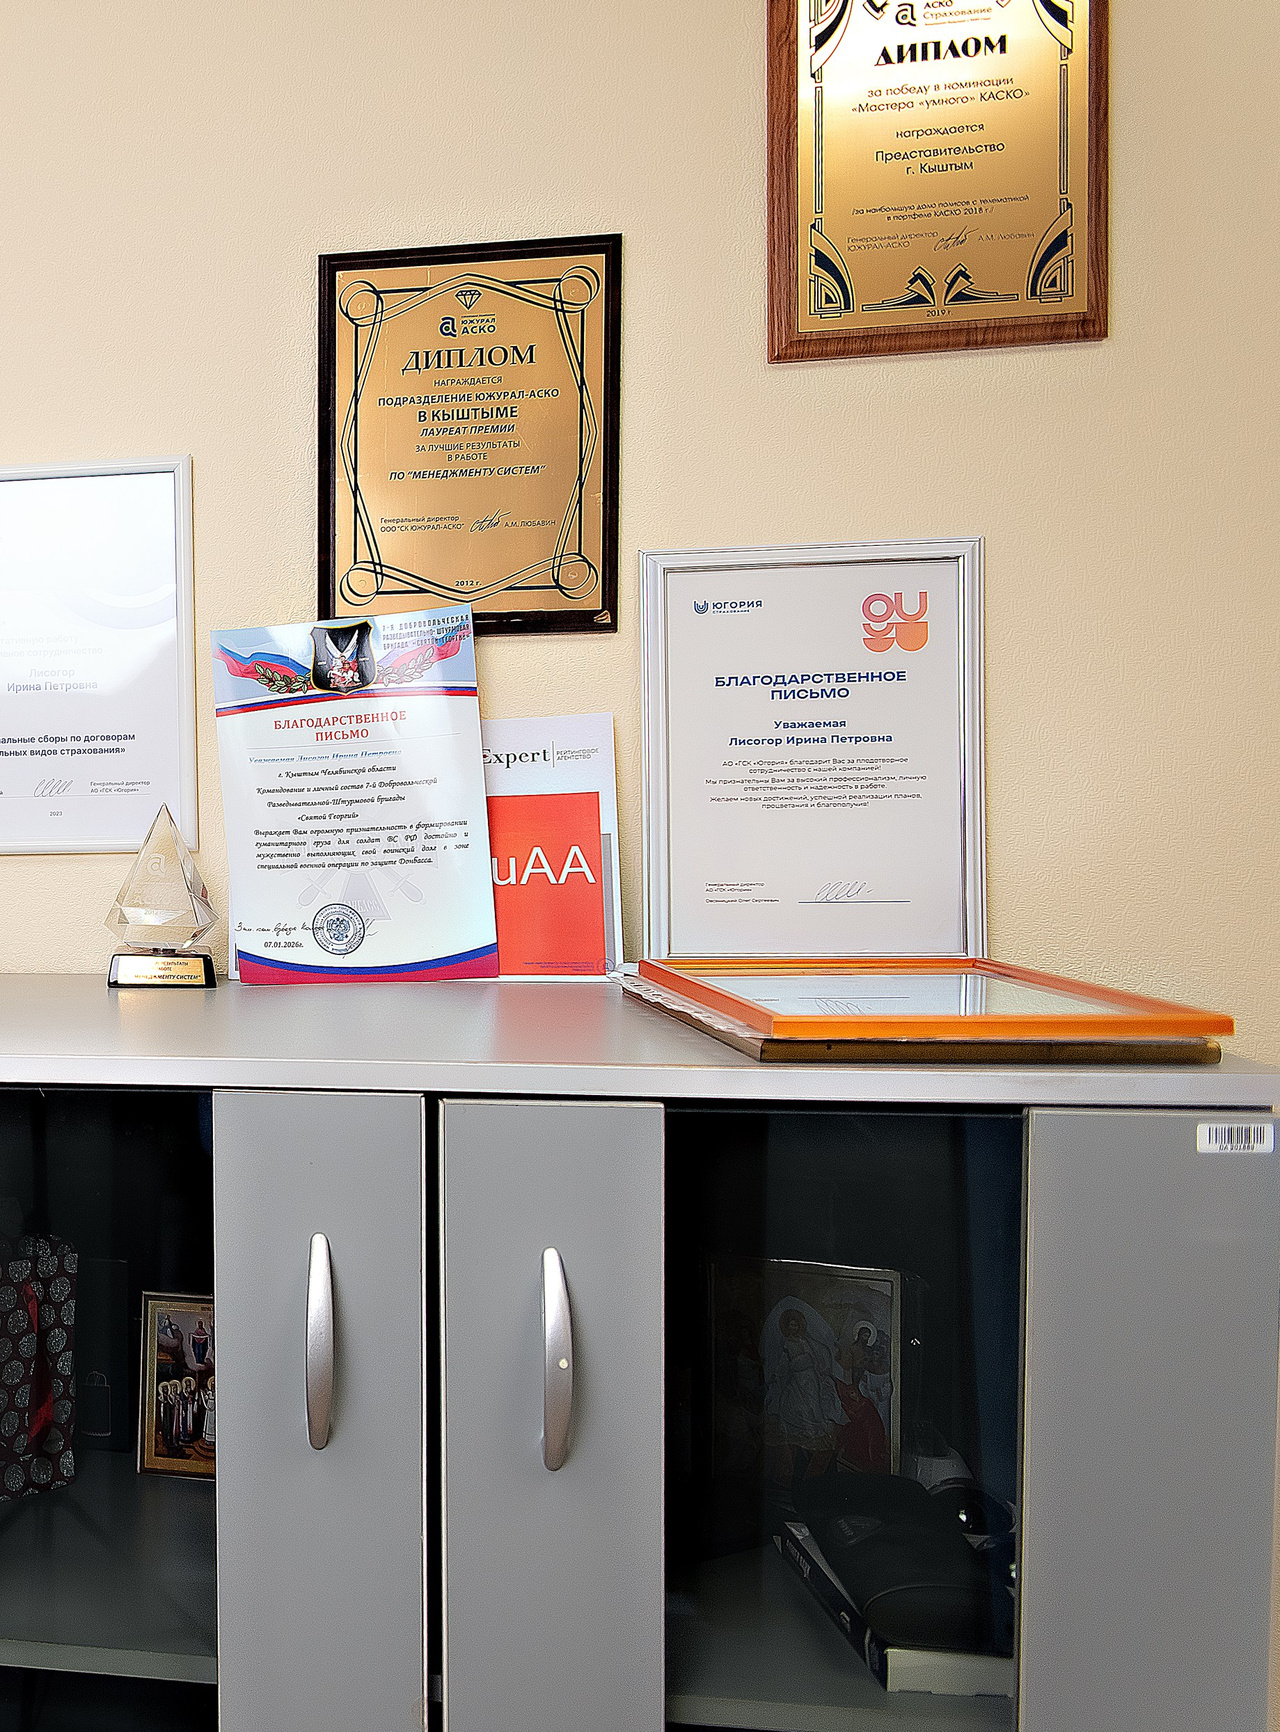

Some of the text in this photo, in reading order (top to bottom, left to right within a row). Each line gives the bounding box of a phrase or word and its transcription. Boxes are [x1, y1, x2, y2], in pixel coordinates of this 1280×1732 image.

[923, 0, 954, 10] АСКО
[922, 7, 993, 20] Страхование
[874, 34, 1007, 67] ДИПЛОМ
[867, 77, 1014, 98] за победу в номинации
[851, 88, 1030, 113] «Мастера «умного» КАСКО»
[895, 123, 985, 140] награждается
[875, 142, 1005, 164] Представительство
[919, 161, 974, 174] Кыштым
[926, 308, 946, 318] 2019
[461, 317, 496, 325] ЮЖУРАЛ
[461, 324, 496, 336] АСКО
[401, 344, 536, 376] ДИПЛОМ
[433, 375, 503, 387] НАГРАЖДАЕТСЯ
[378, 388, 559, 408] ПОДРАЗДЕЛЕНИЕ ЮЖУРАЛ-АСКО
[418, 405, 518, 423] В КЫШТЫМЕ
[420, 423, 516, 437] ЛАУРЕАТ ПРЕМИИ
[415, 440, 521, 453] ЗА ЛУЧШИЕ РЕЗУЛЬТАТЫ
[447, 452, 488, 462] В РАБОТЕ
[389, 471, 405, 481] ПО
[380, 515, 460, 525] Генеральный директор
[519, 519, 556, 527] ЛЮБАВИН
[380, 525, 396, 533] ООО
[712, 600, 763, 610] ЮГОРИЯ
[28, 668, 75, 679] Лисогор
[715, 670, 907, 687] БЛАГОДАРСТВЕННОЕ
[7, 681, 98, 695] Ирина Петровна
[771, 687, 850, 701] ПИСЬМО
[273, 710, 406, 730] БЛАГОДАРСТВЕННОЕ
[773, 720, 847, 730] Уважаемая
[37, 734, 68, 745] сборы
[83, 733, 136, 744] договорам
[315, 728, 369, 742] ПИСЬМО
[728, 734, 893, 747] Лисогор Ирина Петровна
[29, 749, 58, 758] видов
[59, 747, 126, 757] страхования»
[482, 747, 551, 769] Expert
[734, 759, 752, 767] «ГСК
[753, 759, 788, 767] «Югория»
[789, 758, 831, 766] благодарит
[856, 757, 909, 765] плодотворное
[284, 770, 320, 779] Кыштым
[320, 766, 367, 776] Челябинской
[367, 764, 397, 773] области
[748, 767, 807, 775] сотрудничество
[256, 786, 306, 795] Командование
[312, 784, 339, 793] личный
[376, 793, 406, 805] бригады
[253, 829, 291, 838] Выражает
[292, 828, 308, 836] Вам
[309, 828, 344, 837] огромную
[345, 824, 408, 836] признательность
[414, 820, 468, 835] формировании
[254, 841, 307, 850] гуманитарного
[312, 840, 332, 848] груза
[337, 837, 350, 845] для
[356, 835, 381, 845] солдат
[386, 835, 399, 843] ВС
[423, 832, 458, 840] достойно
